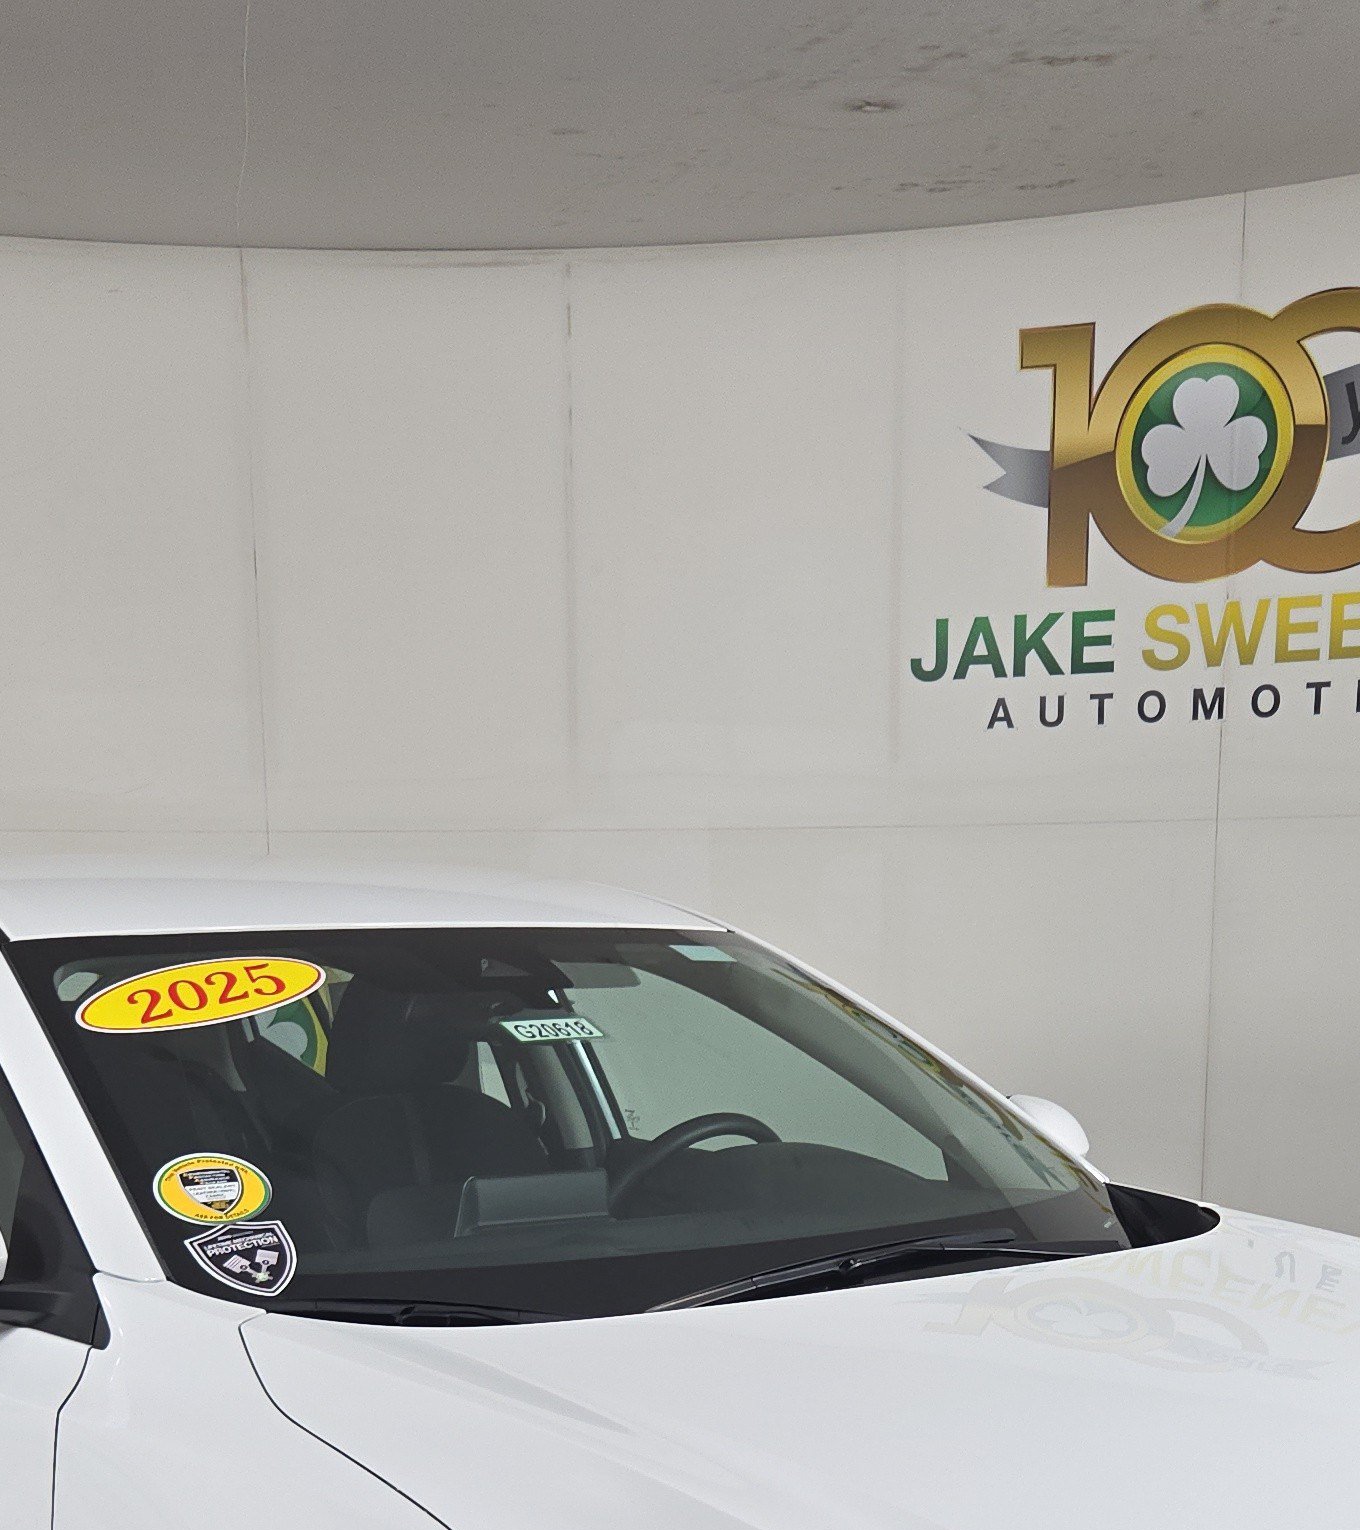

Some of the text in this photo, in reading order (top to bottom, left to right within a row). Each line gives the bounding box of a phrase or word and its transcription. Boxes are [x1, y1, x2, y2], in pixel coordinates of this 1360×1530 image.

[910, 609, 1116, 683] JAKE
[127, 963, 286, 1024] 2025
[513, 1021, 594, 1039] G20618
[206, 1235, 279, 1258] PROTECTION
